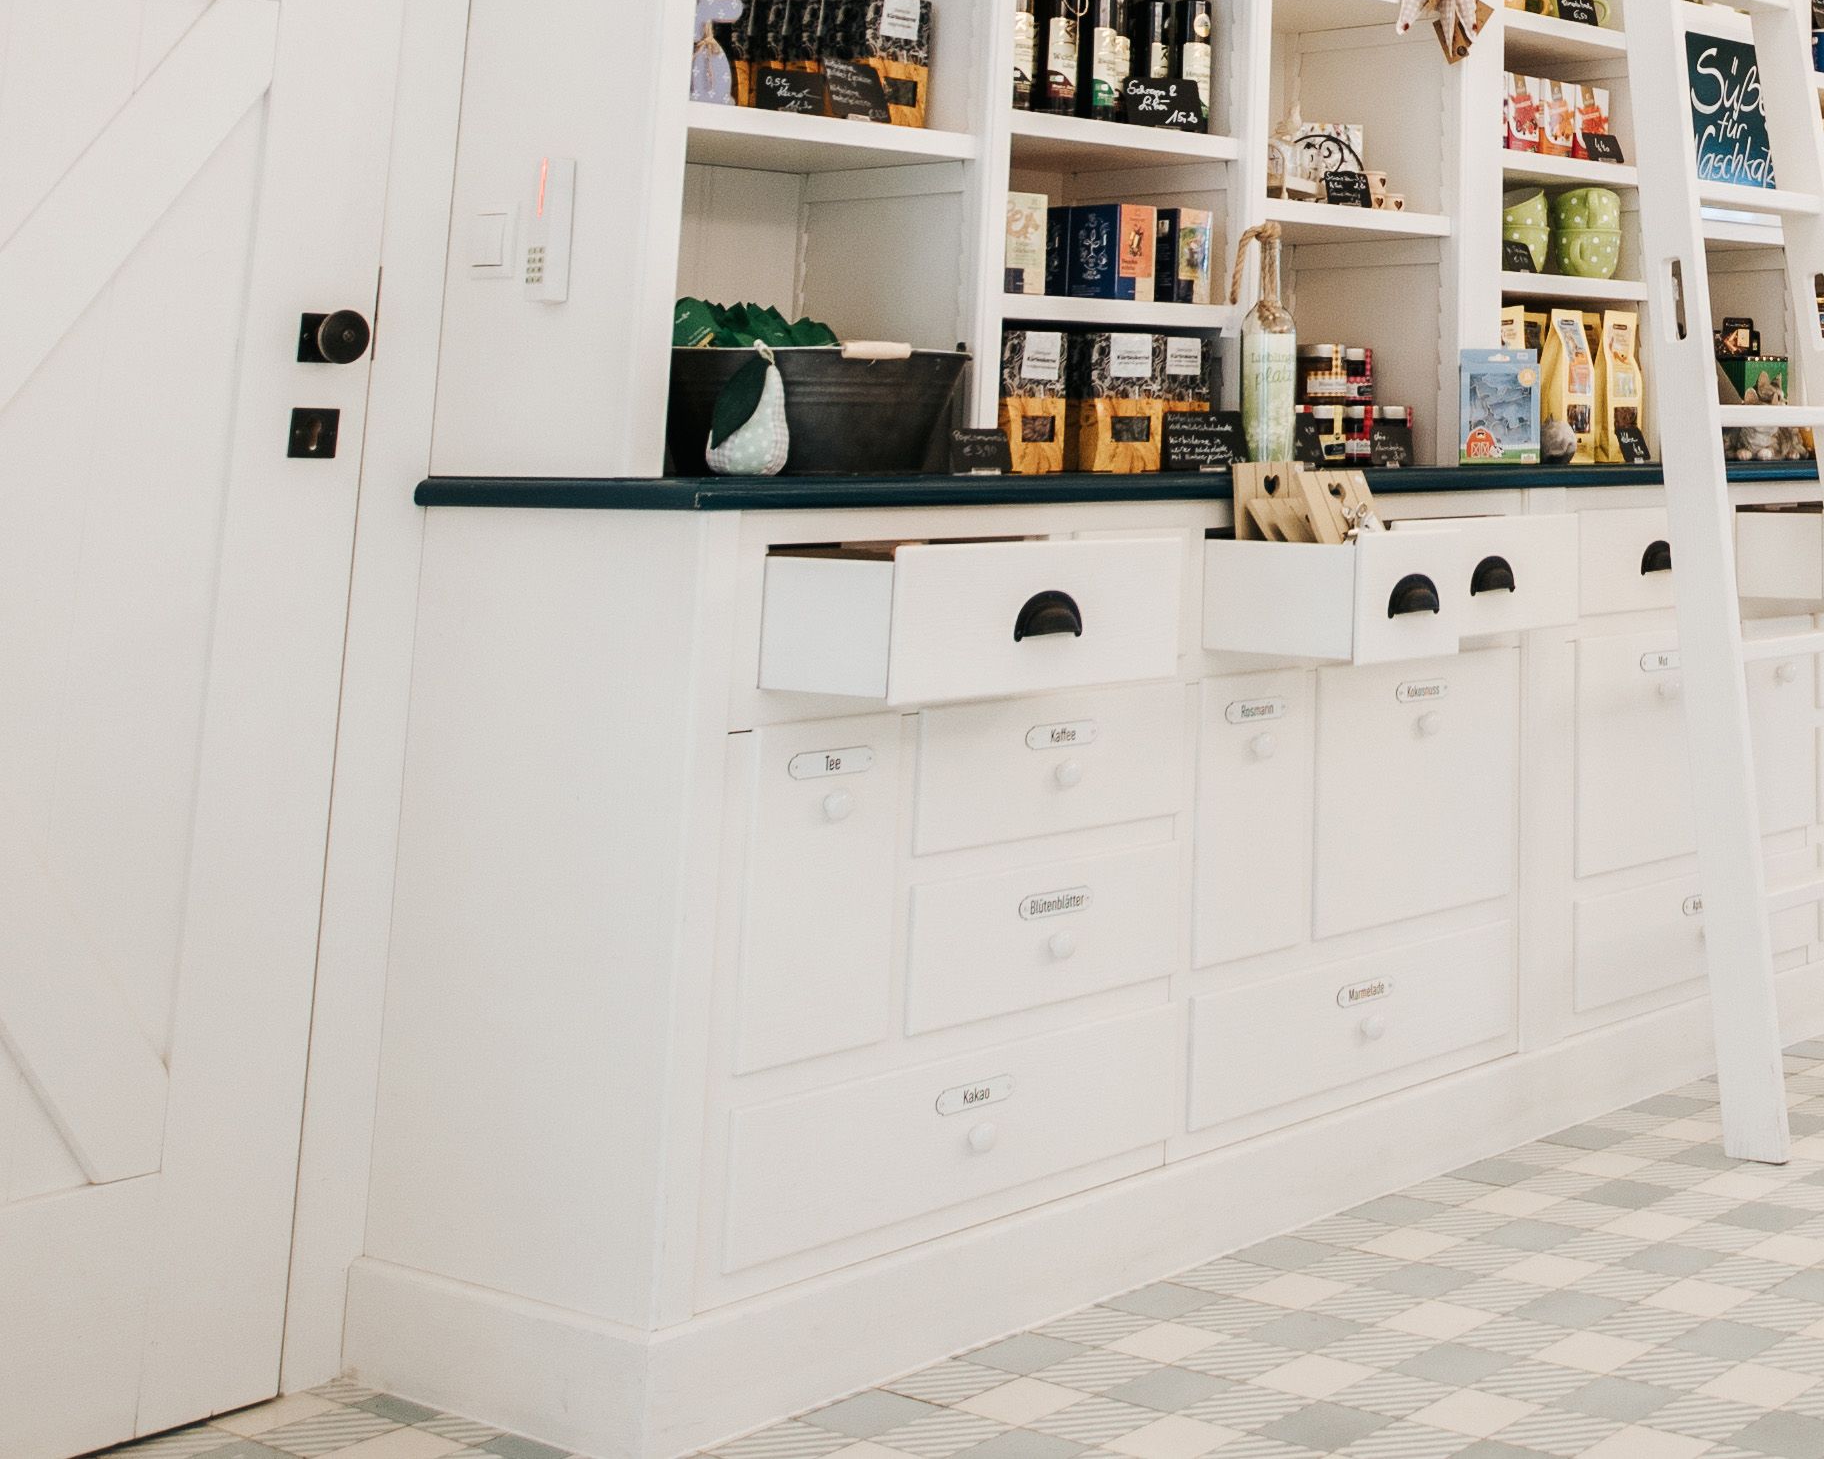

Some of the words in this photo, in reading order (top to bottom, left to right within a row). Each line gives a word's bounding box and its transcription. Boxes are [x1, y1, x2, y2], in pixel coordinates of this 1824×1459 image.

[1050, 727, 1076, 743] Kaffee
[824, 755, 842, 772] Tee
[1029, 892, 1085, 917] Blütenblätter
[1348, 981, 1385, 1002] Marmelade
[962, 1085, 991, 1107] Kakao
